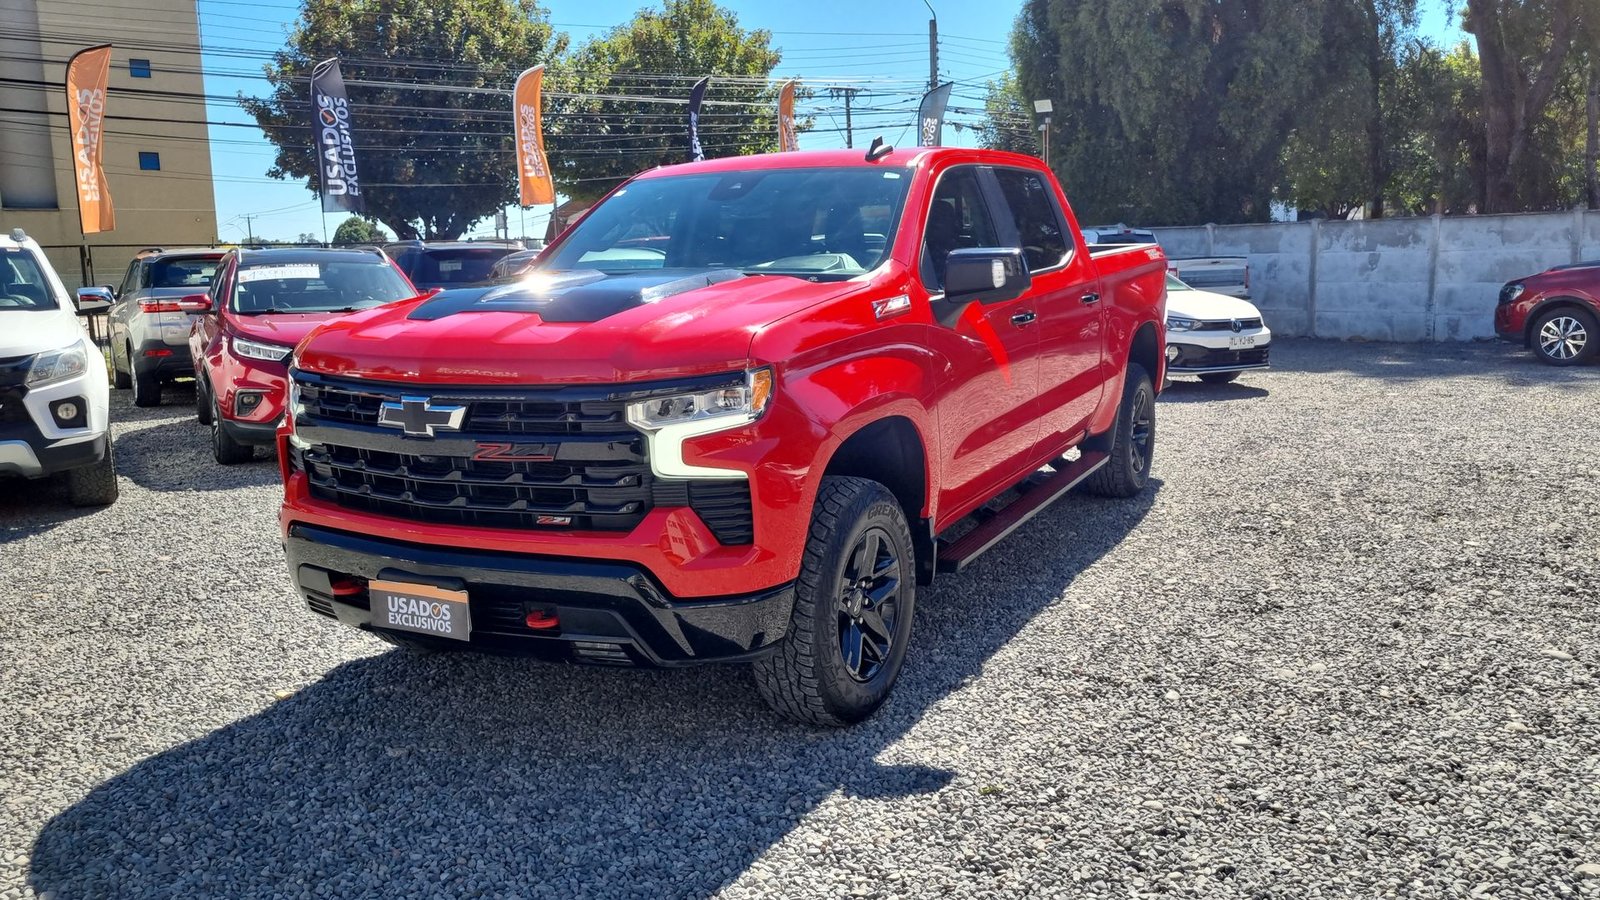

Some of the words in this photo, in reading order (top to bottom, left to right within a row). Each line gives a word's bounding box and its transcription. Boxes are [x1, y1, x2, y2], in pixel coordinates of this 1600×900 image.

[75, 88, 92, 202] USADOS
[317, 94, 348, 196] USADOS
[334, 96, 359, 196] EXCLUSIVOS
[519, 103, 536, 177] USADOS
[472, 442, 560, 462] Z71
[536, 515, 572, 526] Z71
[387, 595, 451, 621] USADOS
[388, 612, 452, 633] EXCLUSIVOS
